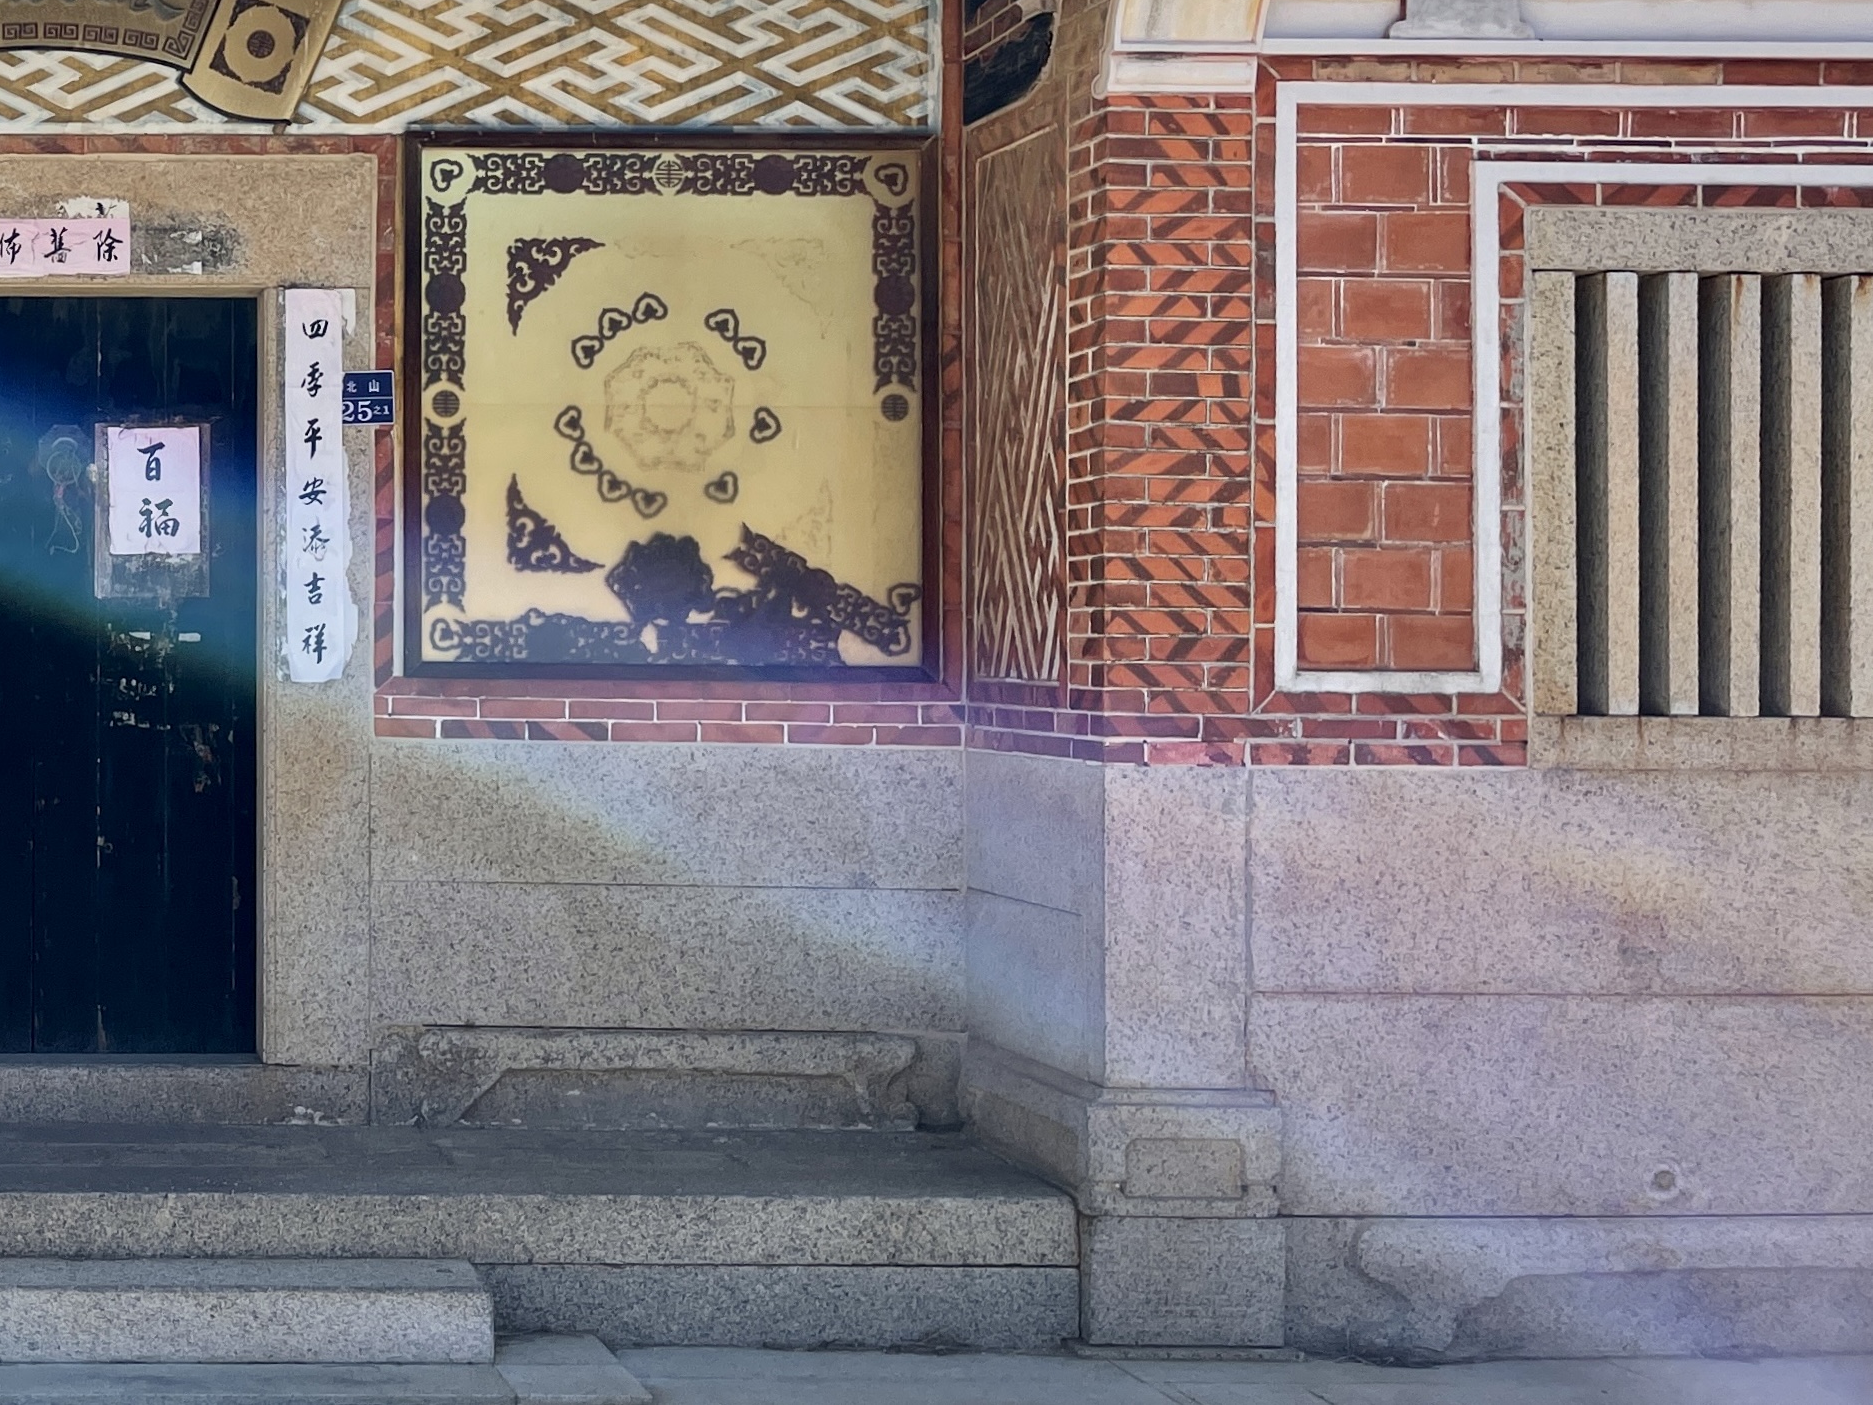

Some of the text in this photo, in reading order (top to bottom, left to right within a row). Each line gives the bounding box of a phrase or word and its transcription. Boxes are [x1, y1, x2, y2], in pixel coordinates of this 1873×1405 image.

[346, 379, 379, 393] 北山
[137, 441, 181, 539] 百福
[297, 318, 331, 665] 四季平安添吉祥
